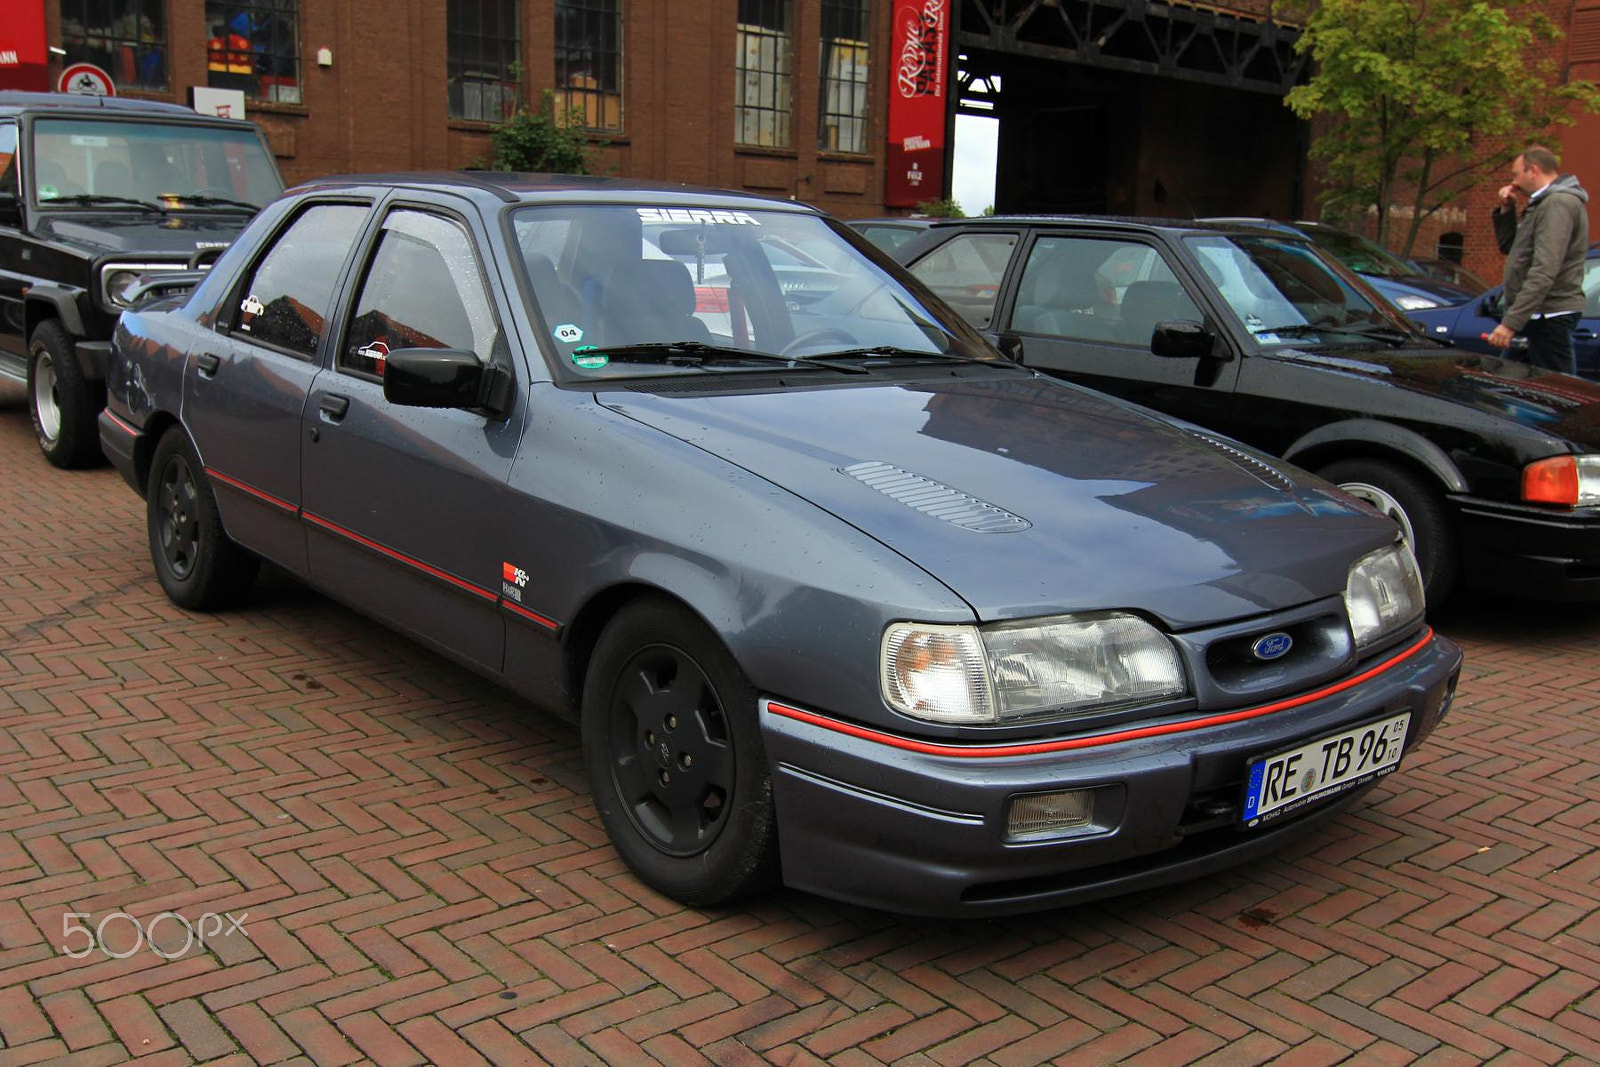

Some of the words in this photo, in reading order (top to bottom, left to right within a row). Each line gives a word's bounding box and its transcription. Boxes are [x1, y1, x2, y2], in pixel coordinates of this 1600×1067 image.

[636, 207, 761, 226] SIERRA
[560, 329, 577, 337] 04
[1264, 637, 1285, 654] Ford
[1393, 719, 1404, 733] 05
[1387, 747, 1398, 760] 10
[1262, 753, 1303, 807] RE
[1320, 736, 1355, 784] TB
[1356, 724, 1390, 771] 96
[1247, 795, 1255, 809] D
